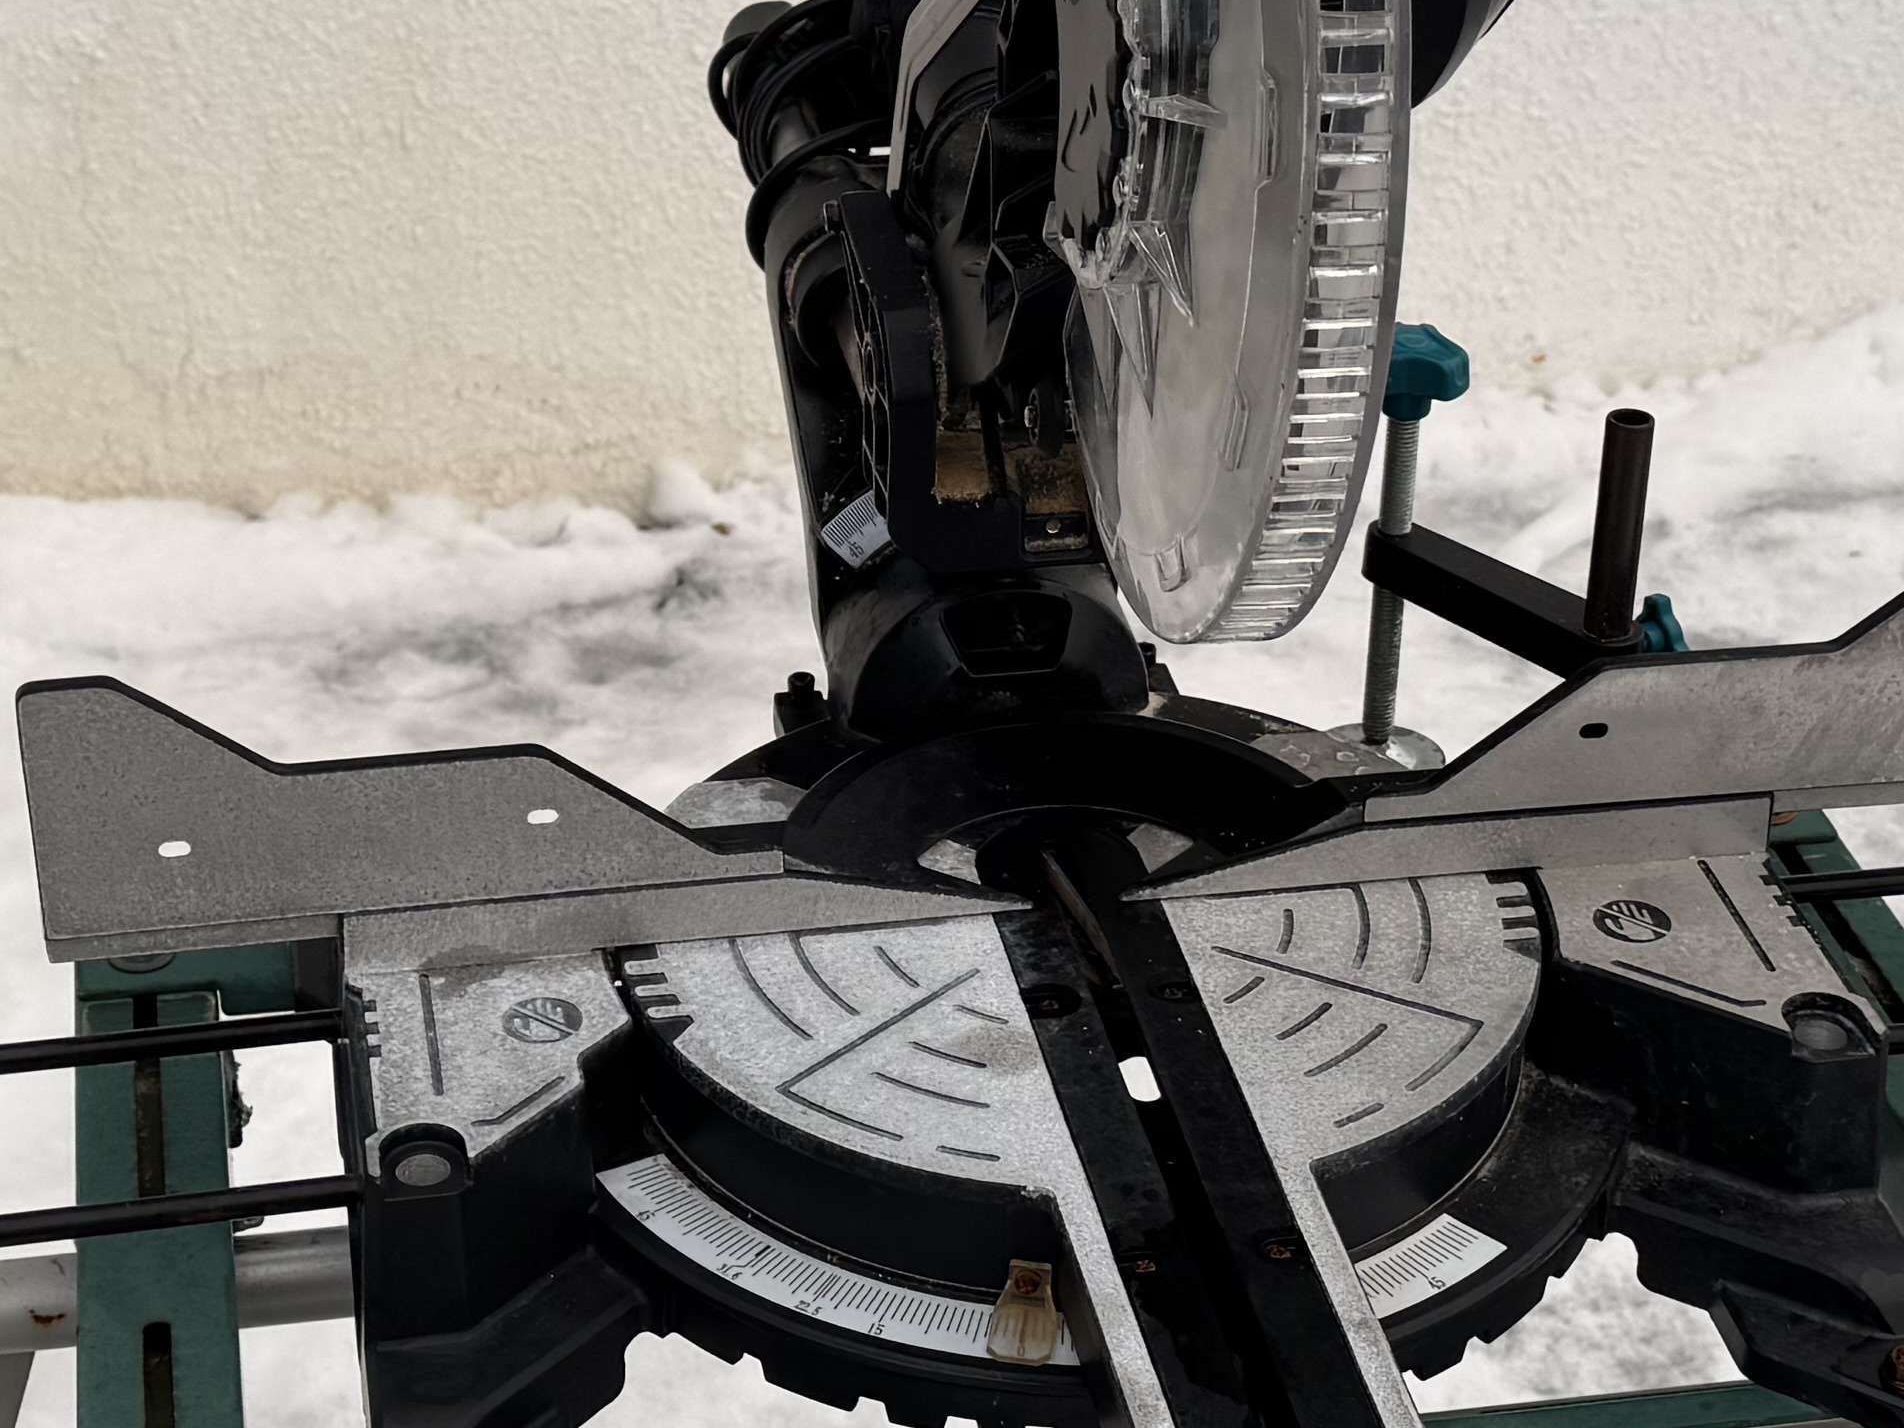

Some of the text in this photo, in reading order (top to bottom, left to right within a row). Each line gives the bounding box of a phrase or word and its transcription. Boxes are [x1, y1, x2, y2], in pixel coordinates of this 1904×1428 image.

[1428, 1276, 1447, 1290] 45
[794, 1300, 823, 1316] 22.5
[868, 1323, 886, 1336] 15
